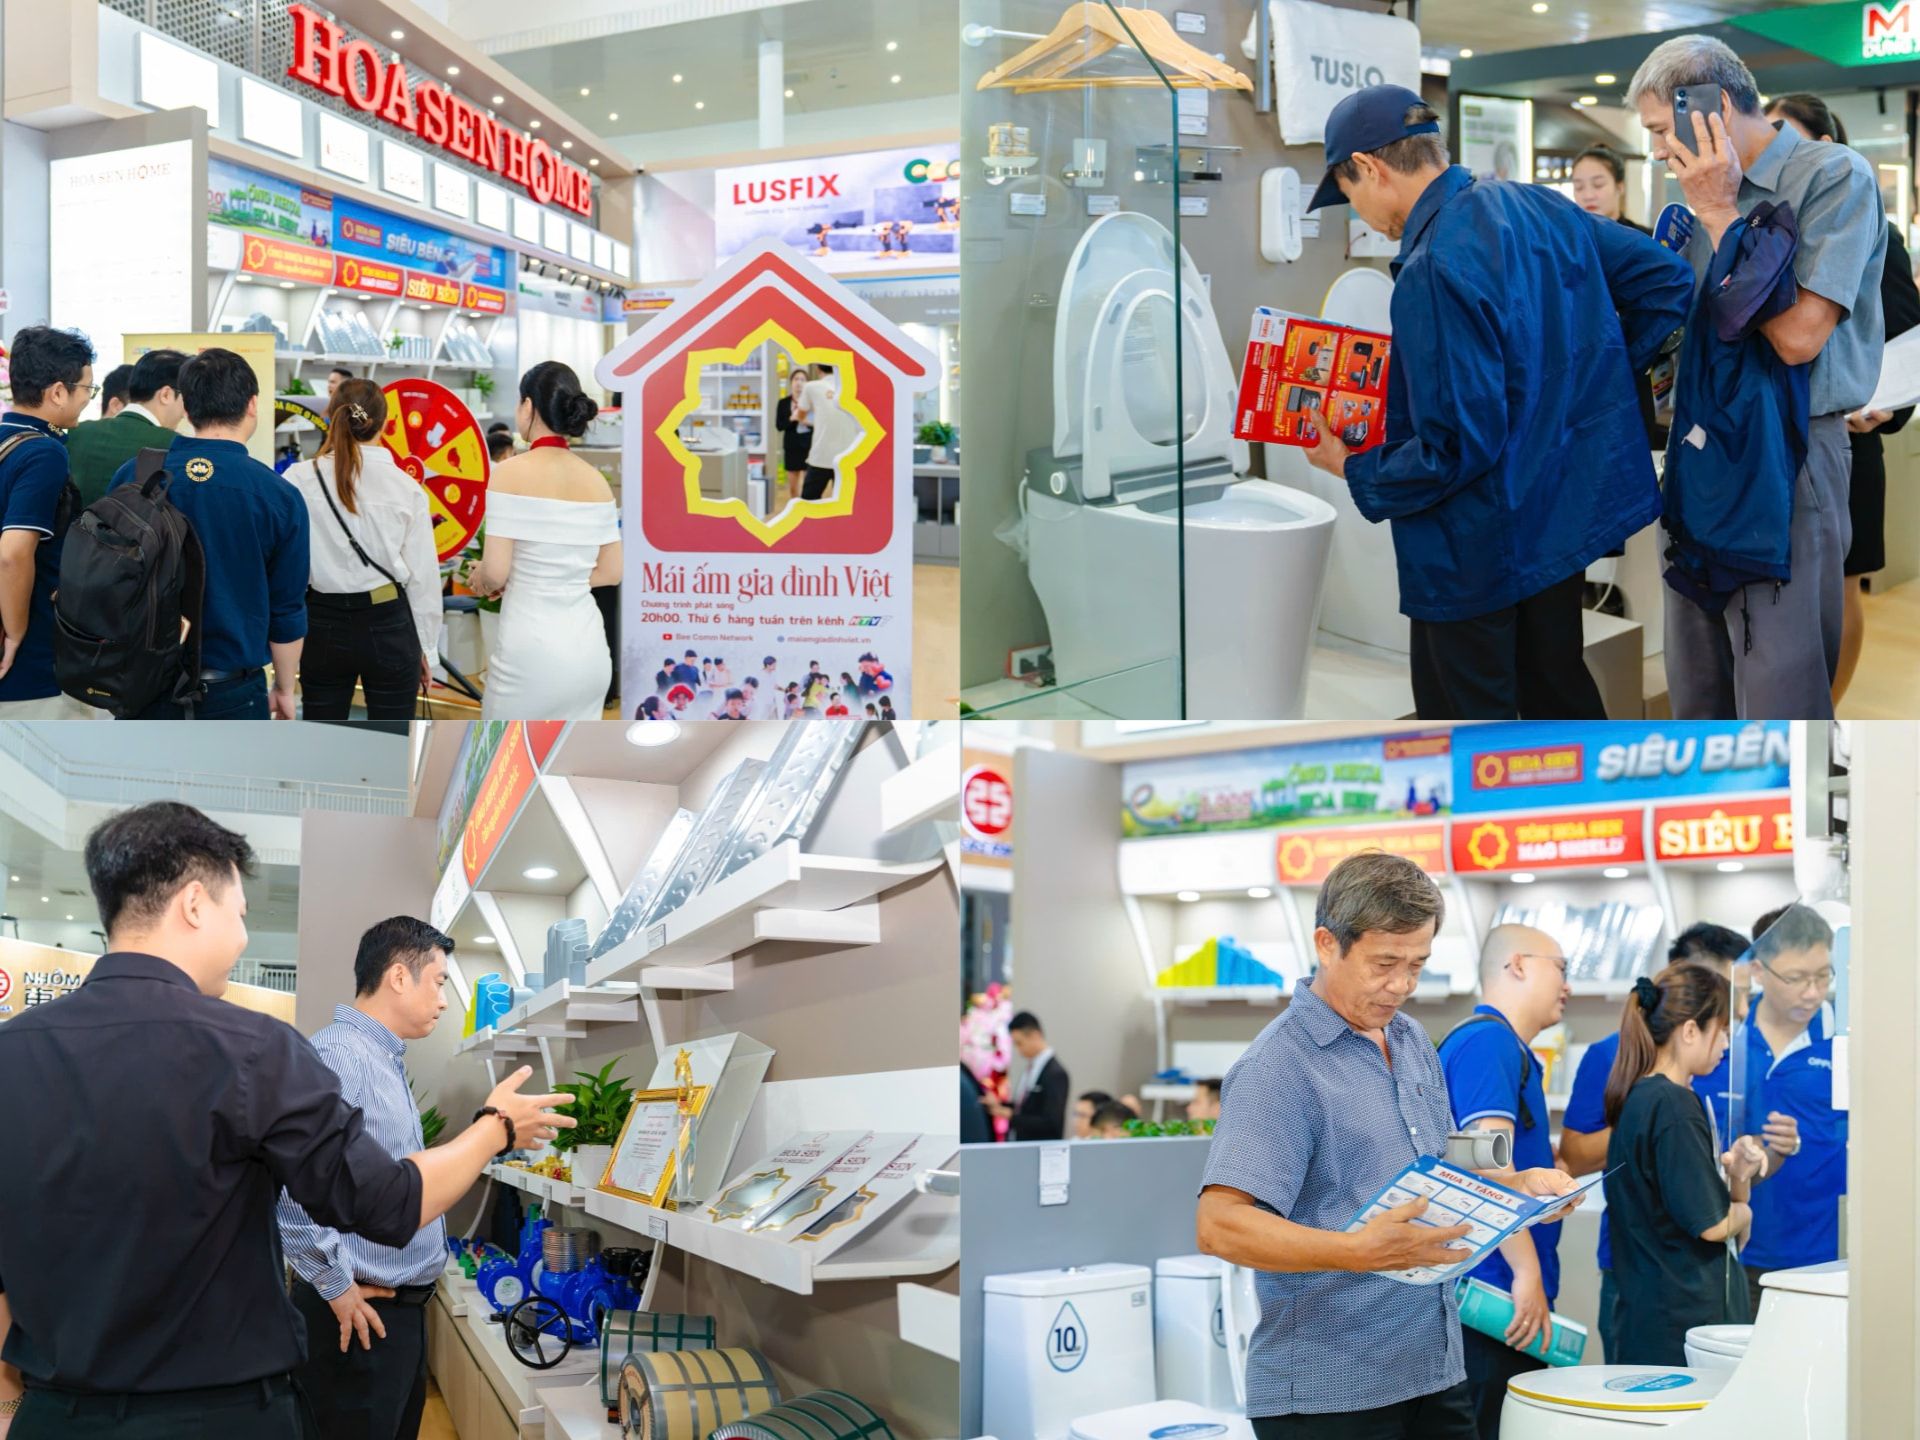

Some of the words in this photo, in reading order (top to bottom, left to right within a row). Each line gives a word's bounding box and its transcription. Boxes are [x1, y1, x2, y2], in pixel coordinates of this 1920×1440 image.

[288, 4, 417, 131] HOA
[416, 80, 502, 171] SEN
[502, 128, 593, 217] HOME
[127, 163, 171, 182] HOME
[733, 174, 840, 205] LUSFIX
[386, 233, 416, 256] SIÊU
[406, 277, 436, 300] SIÊU
[642, 562, 685, 593] Mái
[692, 562, 730, 594] ấm
[737, 568, 773, 603] gia
[781, 565, 838, 597] đình
[843, 565, 892, 602] Việt
[713, 614, 721, 623] 6
[728, 615, 754, 626] hàng
[789, 616, 812, 625] trên
[817, 616, 844, 625] kênh
[1596, 732, 1698, 781] SIÊU
[1659, 809, 1763, 856] SIÊU
[24, 969, 80, 986] NHÔM
[1439, 1171, 1463, 1184] MUA
[1054, 1326, 1077, 1353] 10
